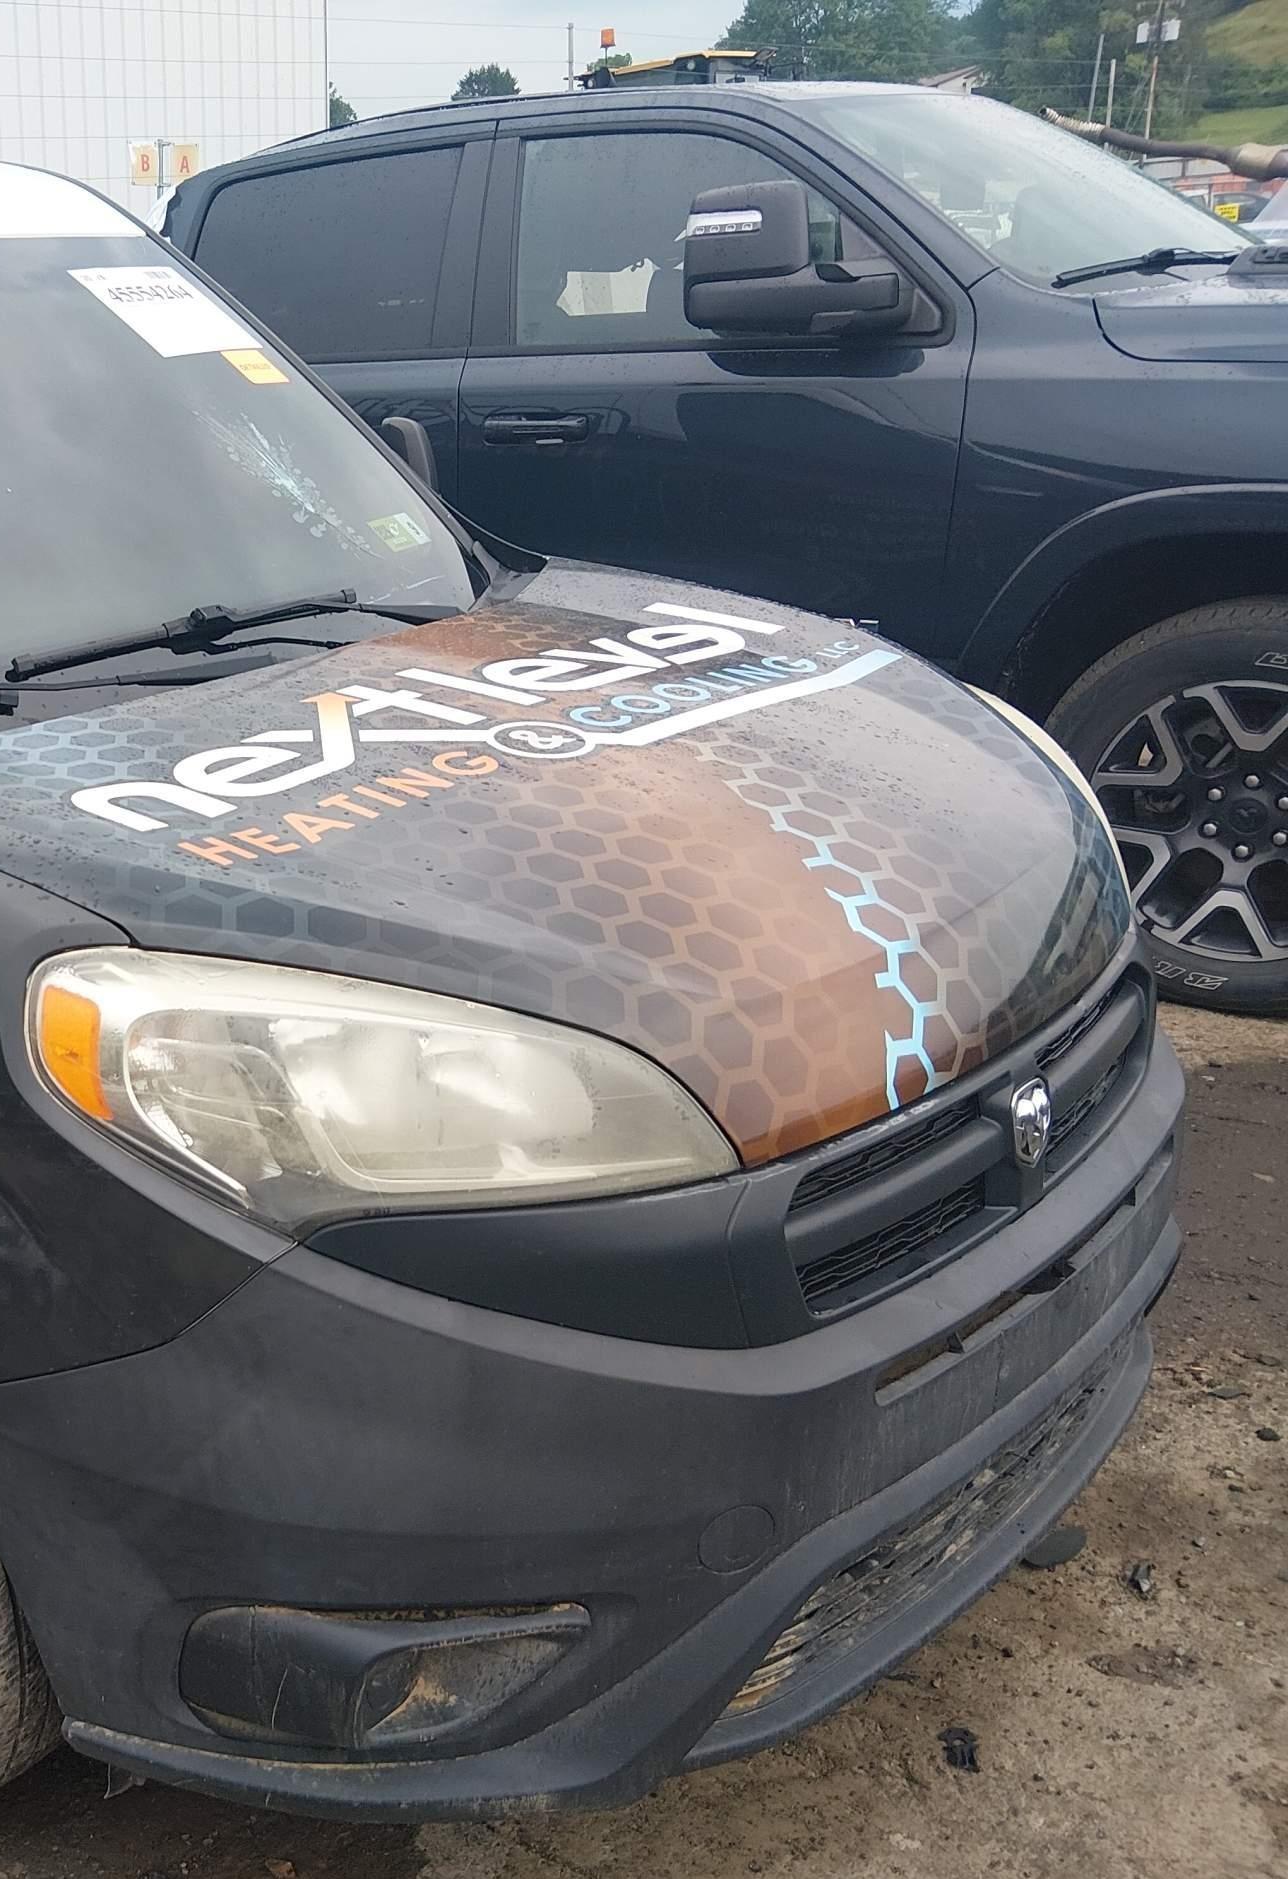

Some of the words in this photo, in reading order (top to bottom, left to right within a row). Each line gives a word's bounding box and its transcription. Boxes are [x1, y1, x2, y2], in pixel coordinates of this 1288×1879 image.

[140, 153, 151, 173] B
[179, 154, 191, 174] A
[176, 750, 500, 866] HEATING
[568, 655, 818, 727] COOLING
[815, 640, 861, 659] LLC
